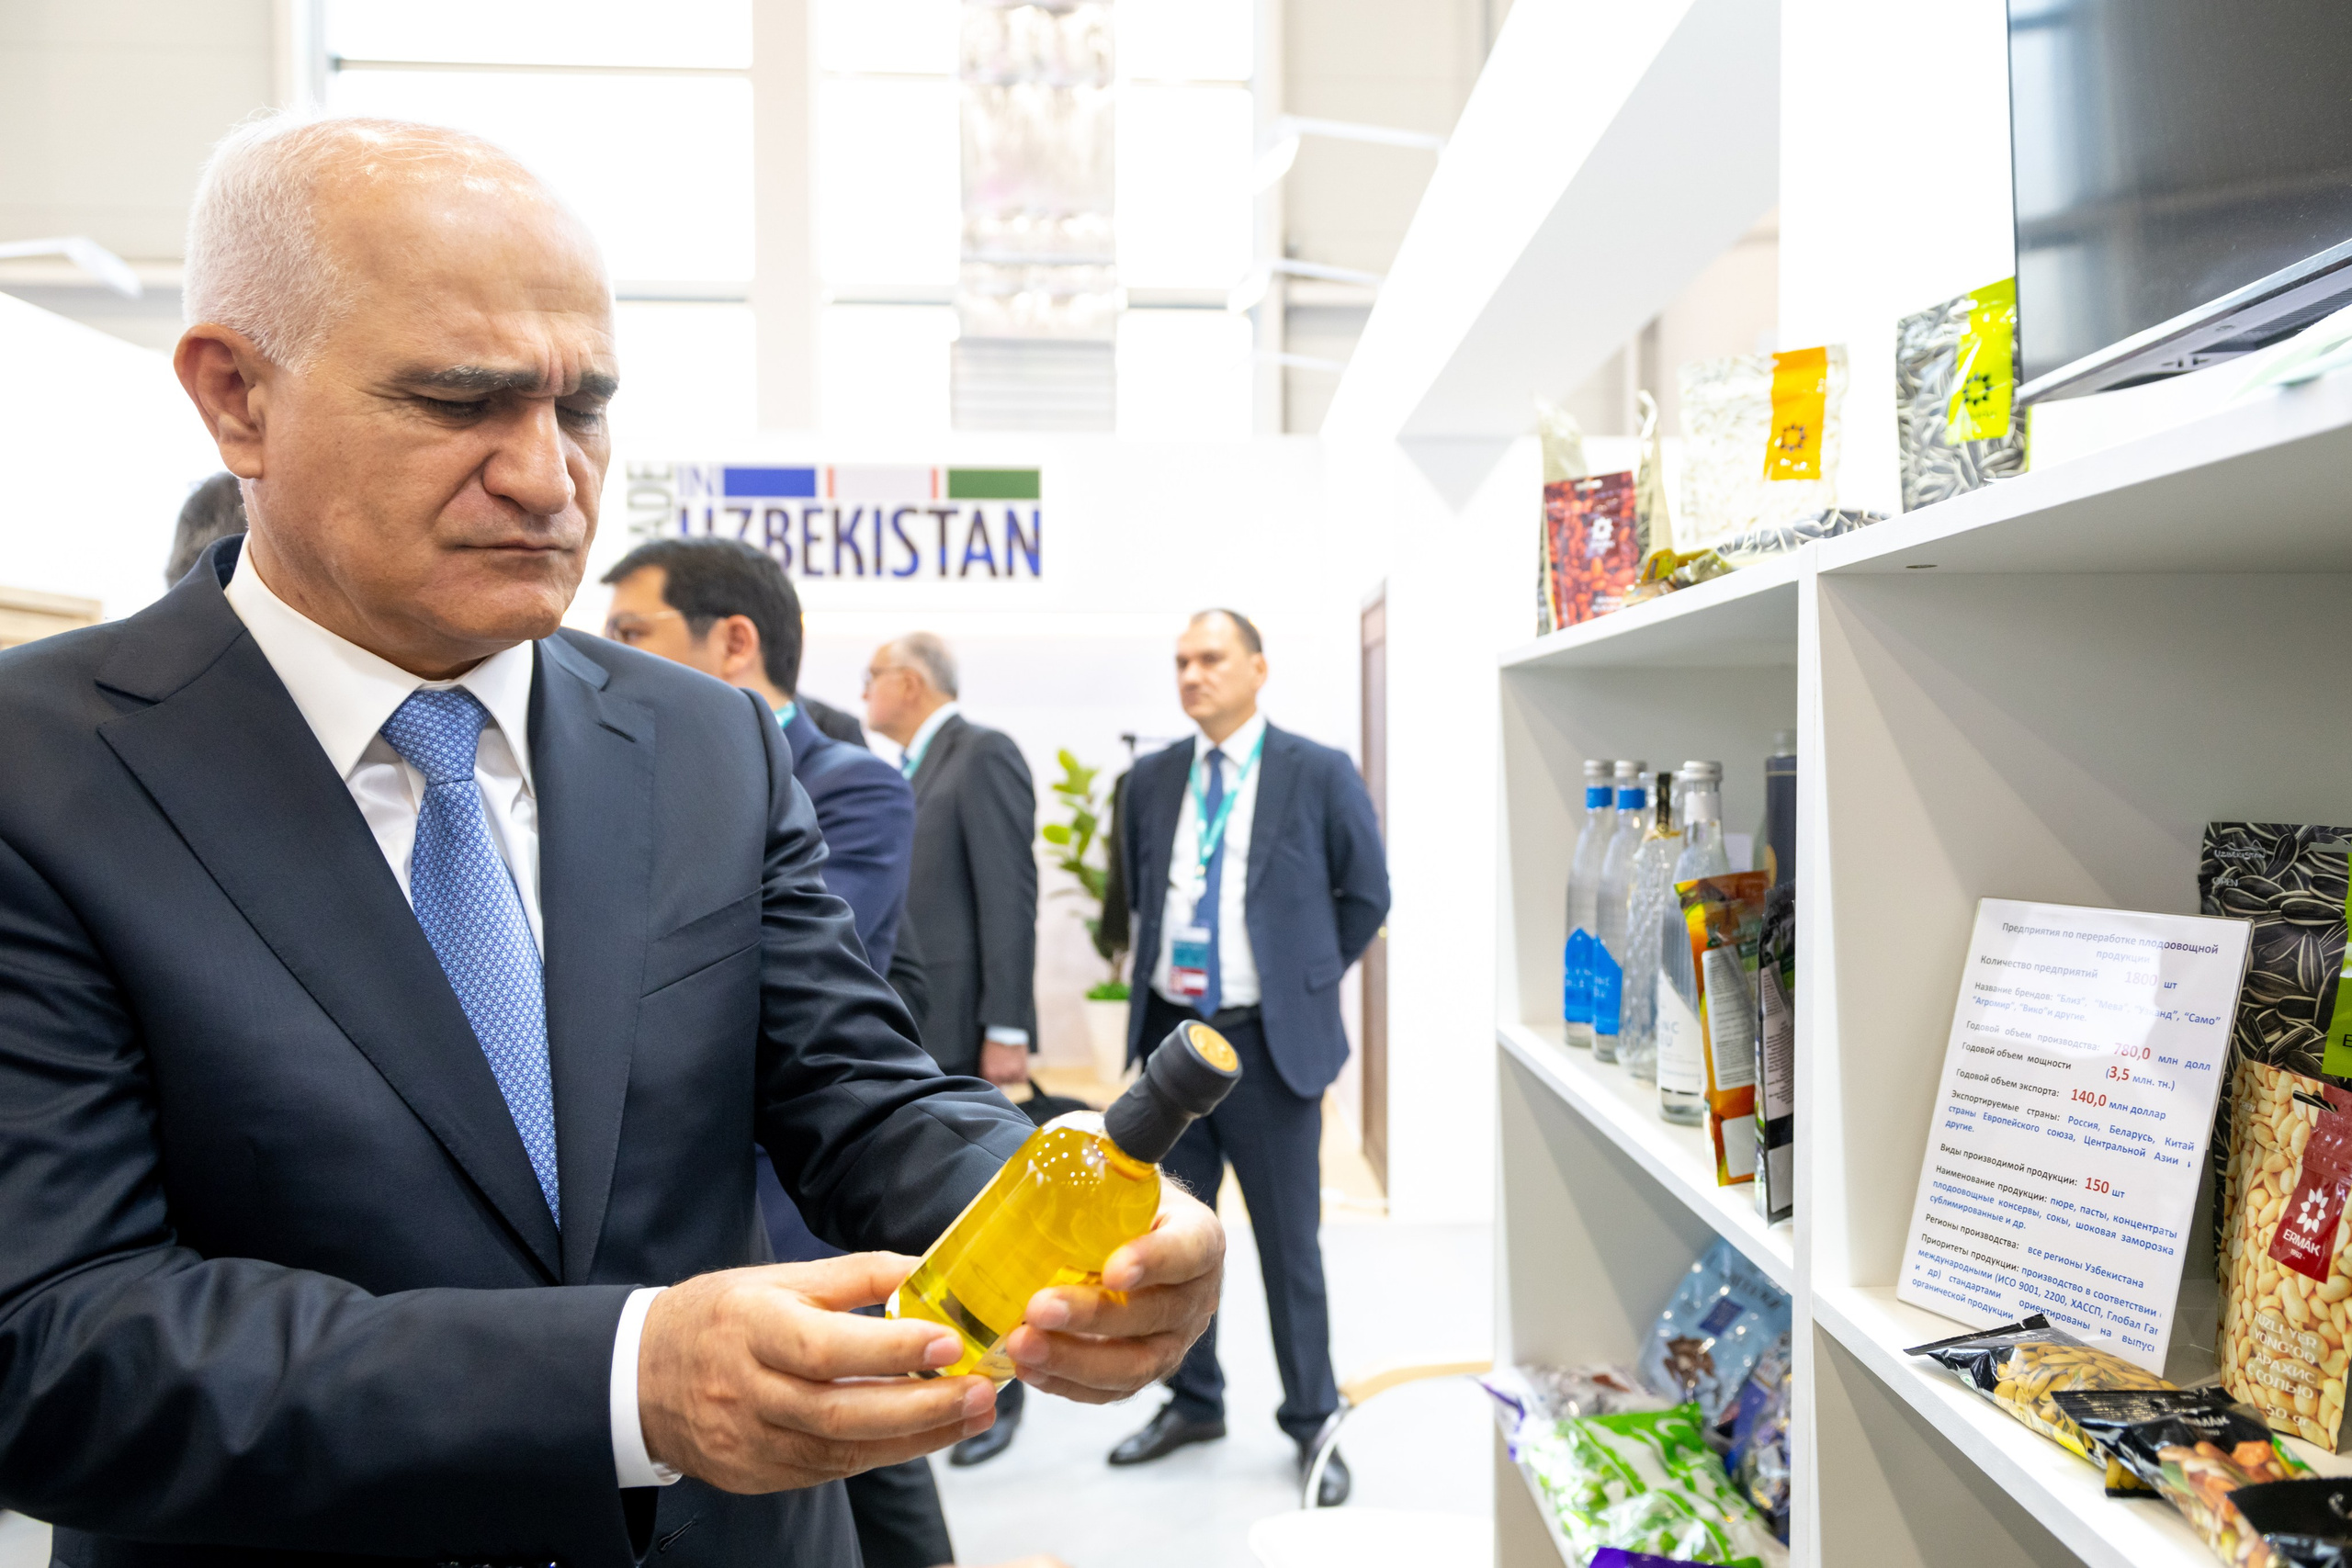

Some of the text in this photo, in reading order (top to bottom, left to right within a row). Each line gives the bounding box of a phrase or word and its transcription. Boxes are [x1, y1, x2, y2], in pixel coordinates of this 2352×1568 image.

[2211, 876, 2239, 887] OPEN
[2002, 922, 2219, 954] Предприятия по переработке плодоовощной
[2096, 951, 2150, 964] продукции
[1974, 982, 2012, 995] Название
[2014, 987, 2052, 1000] брендов:
[1980, 954, 2177, 989] Количество предприятий 1800 шт
[2053, 1010, 2086, 1021] другие.
[1962, 1042, 2176, 1091] Годовой объем мощности (3,5 млн. тн.)
[1966, 1021, 2211, 1073] Годовой объем производства: 780,0 млн долл
[1956, 1068, 2166, 1121] Годовой объем экспорта: 140,0 млн доллар
[1945, 1120, 1974, 1133] другие.
[1948, 1106, 1976, 1118] страны
[1983, 1111, 2040, 1133] Европейского
[2047, 1129, 2075, 1143] союза,
[2084, 1135, 2146, 1157] Центральной
[2154, 1152, 2179, 1165] Азии
[1951, 1089, 2195, 1151] Экспортируемые страны: Россия, Беларусь, Китай
[1940, 1143, 2125, 1199] Виды производимой продукции: 150 шт
[1929, 1195, 2004, 1223] сублимированные
[2012, 1220, 2026, 1230] др.
[1933, 1180, 1995, 1204] плодоовощные
[1998, 1200, 2041, 1219] консервы,
[2075, 1222, 2117, 1239] шоковая
[2120, 1235, 2174, 1256] заморозка
[1936, 1165, 2177, 1239] Наименование продукции: пюре, пасты, концентраты
[1925, 1213, 2143, 1289] Регионы производства: все регионы Узбекистана
[1917, 1249, 2158, 1336] международными (ИСО 9001, 2200, ХАССП, Глобал Га
[1921, 1233, 1969, 1256] Приоритеты
[1971, 1251, 2019, 1272] продукции:
[2021, 1268, 2084, 1292] производство
[2093, 1291, 2157, 1317] соответствии
[1912, 1279, 2013, 1319] органической продукции
[1927, 1269, 1941, 1280] др)
[1949, 1276, 2001, 1299] стандартами
[2018, 1299, 2090, 1329] ориентированы
[2100, 1327, 2112, 1337] на
[2255, 1311, 2317, 1348] TUZLI YER
[2256, 1352, 2315, 1383] АРАХИС
[2256, 1369, 2313, 1399] СОЛЬЮ
[2266, 1404, 2288, 1419] 50
